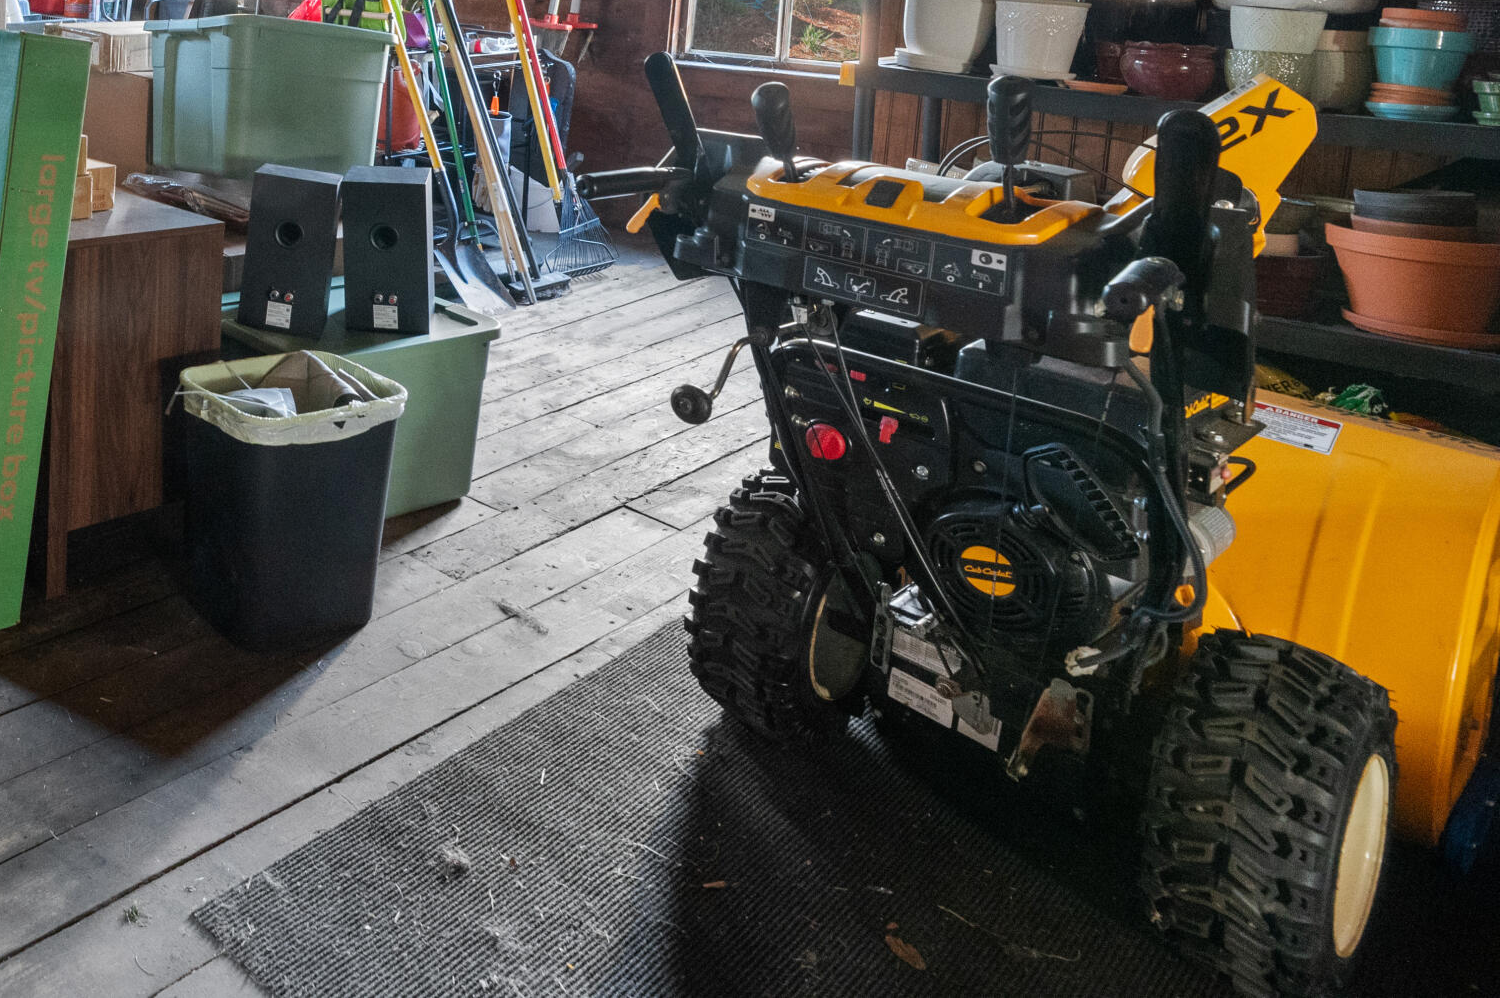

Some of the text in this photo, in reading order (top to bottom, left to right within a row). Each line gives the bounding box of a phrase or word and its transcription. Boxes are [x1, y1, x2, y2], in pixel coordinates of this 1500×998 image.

[29, 153, 66, 248] large
[6, 259, 49, 445] tv/picture
[1275, 407, 1319, 424] DANGER
